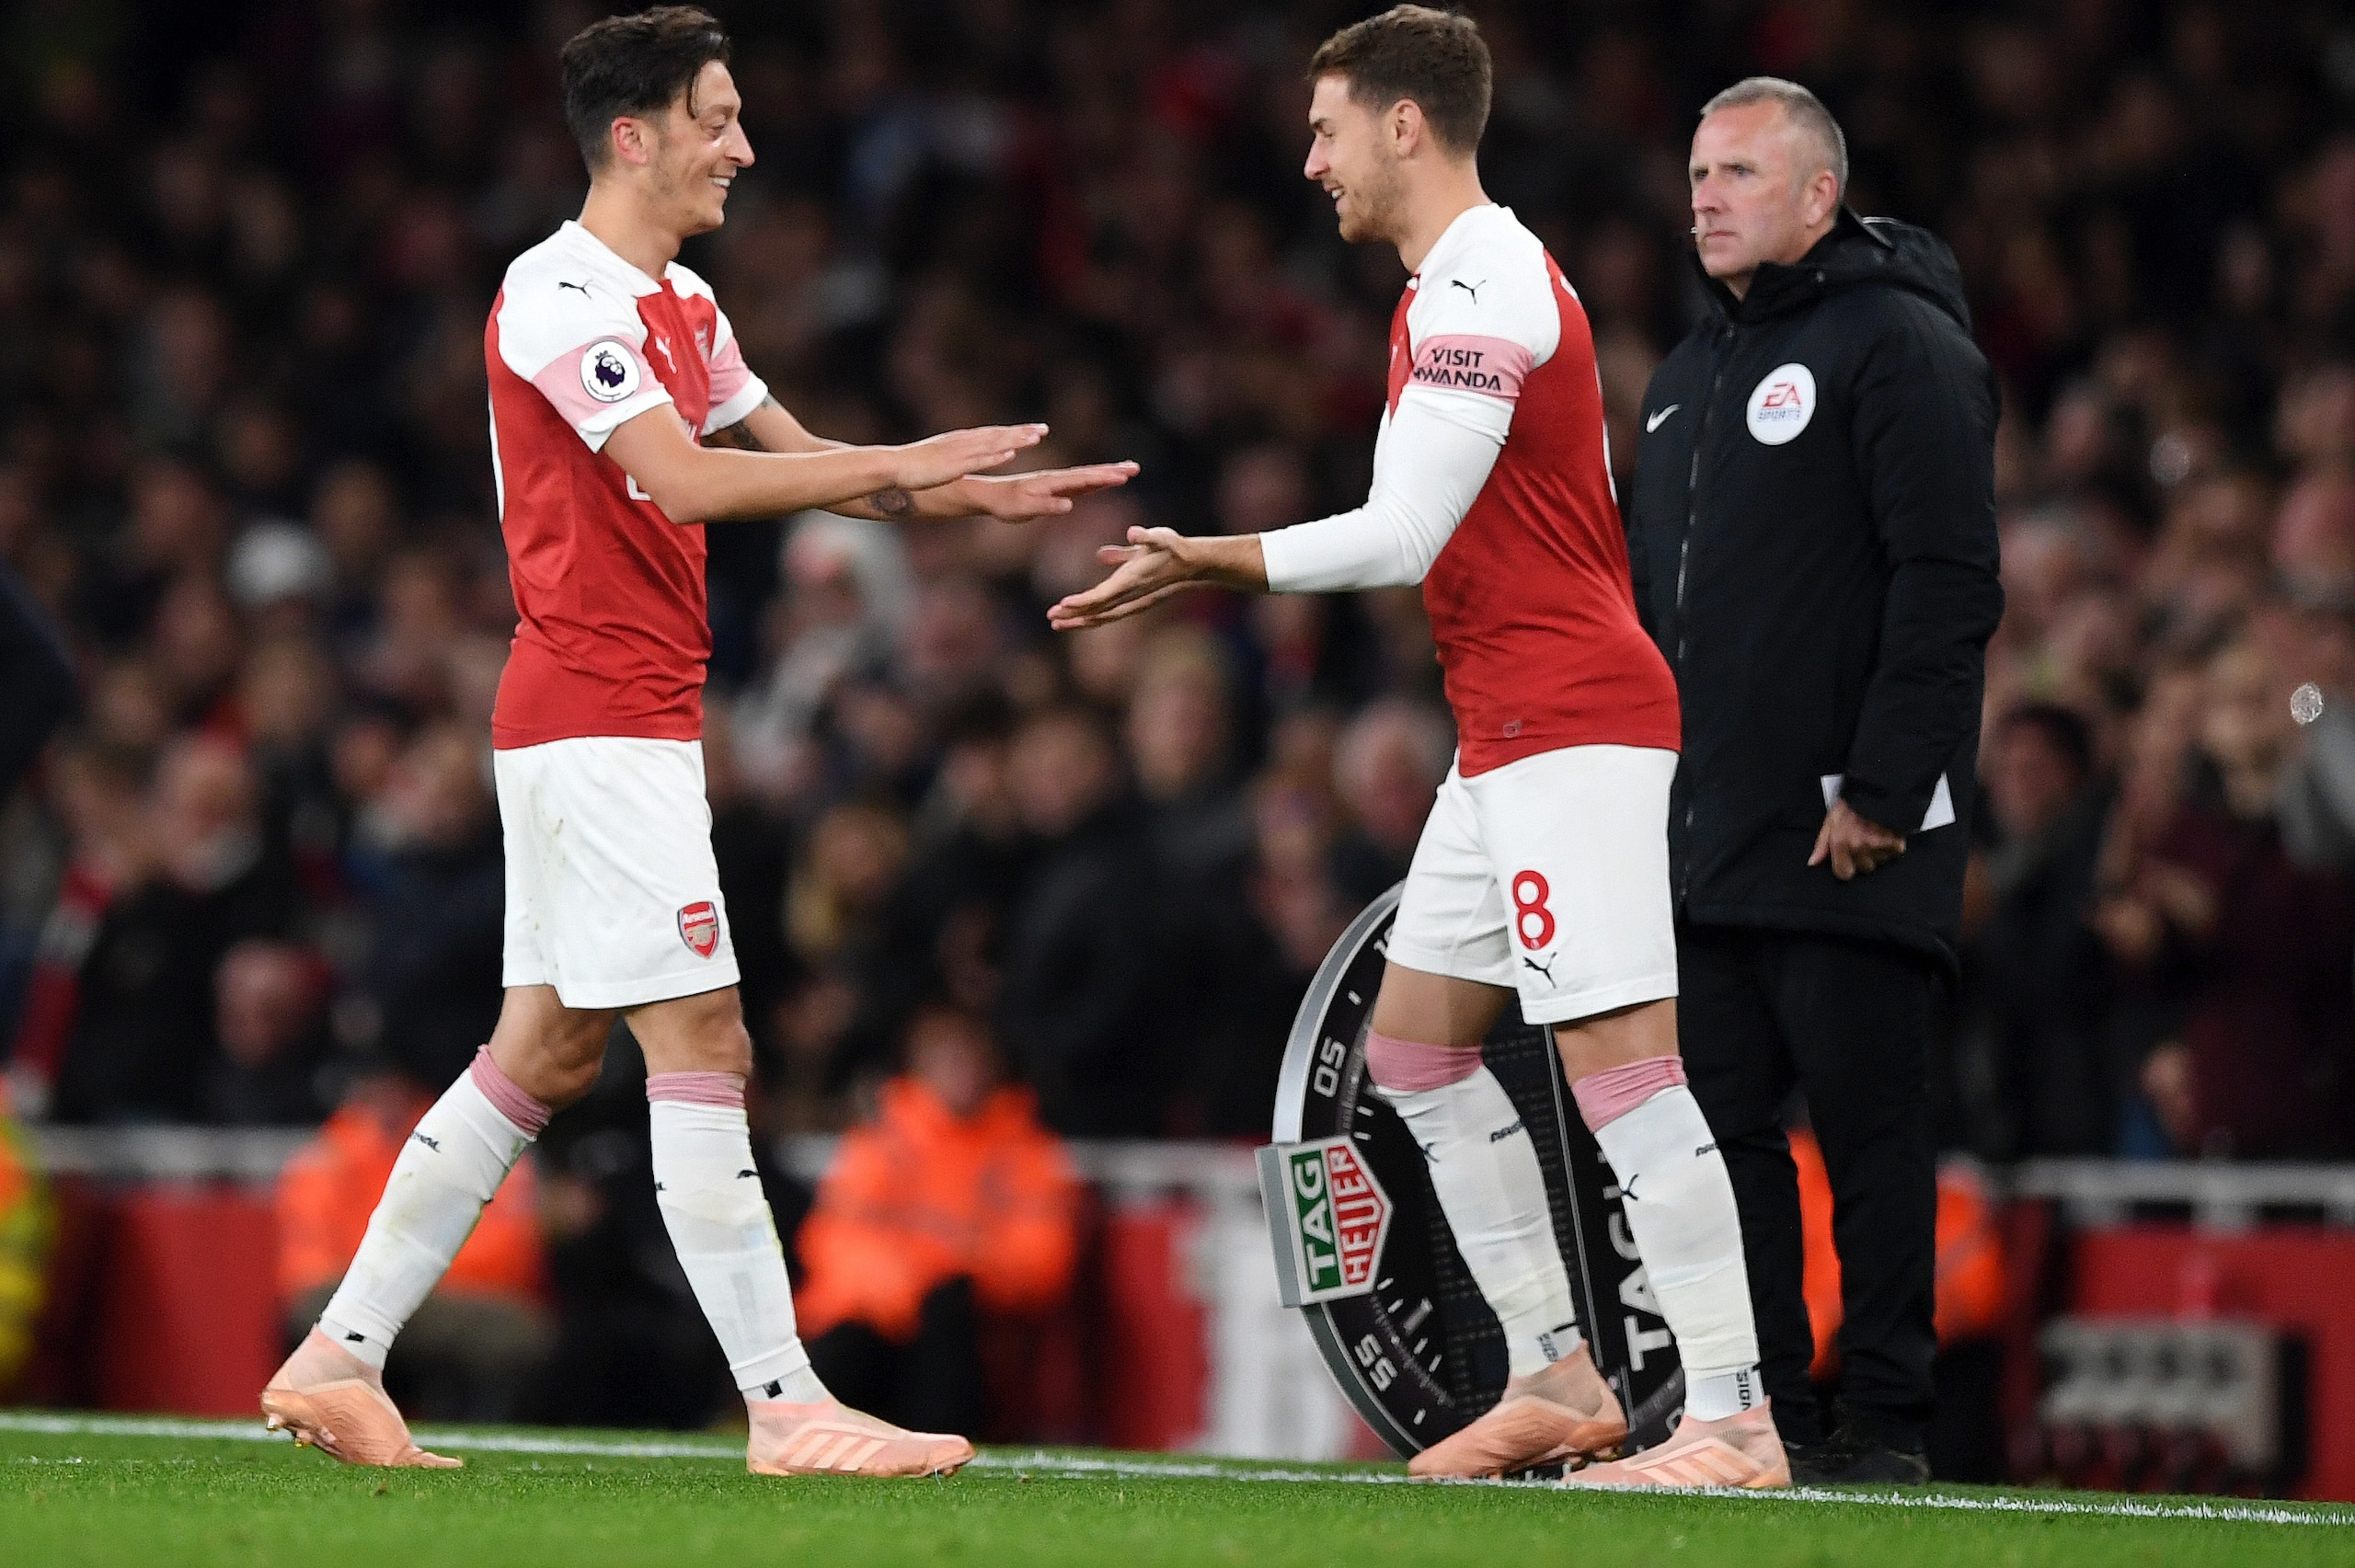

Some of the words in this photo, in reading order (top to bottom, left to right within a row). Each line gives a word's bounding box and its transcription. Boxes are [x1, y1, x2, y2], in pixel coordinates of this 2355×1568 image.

[1431, 349, 1484, 368] VISIT
[1763, 382, 1800, 408] EA
[1511, 869, 1555, 950] 8
[1314, 1036, 1347, 1098] 05
[1294, 1158, 1337, 1286] TAG
[1330, 1150, 1383, 1281] HEUER
[1354, 1333, 1398, 1391] 55
